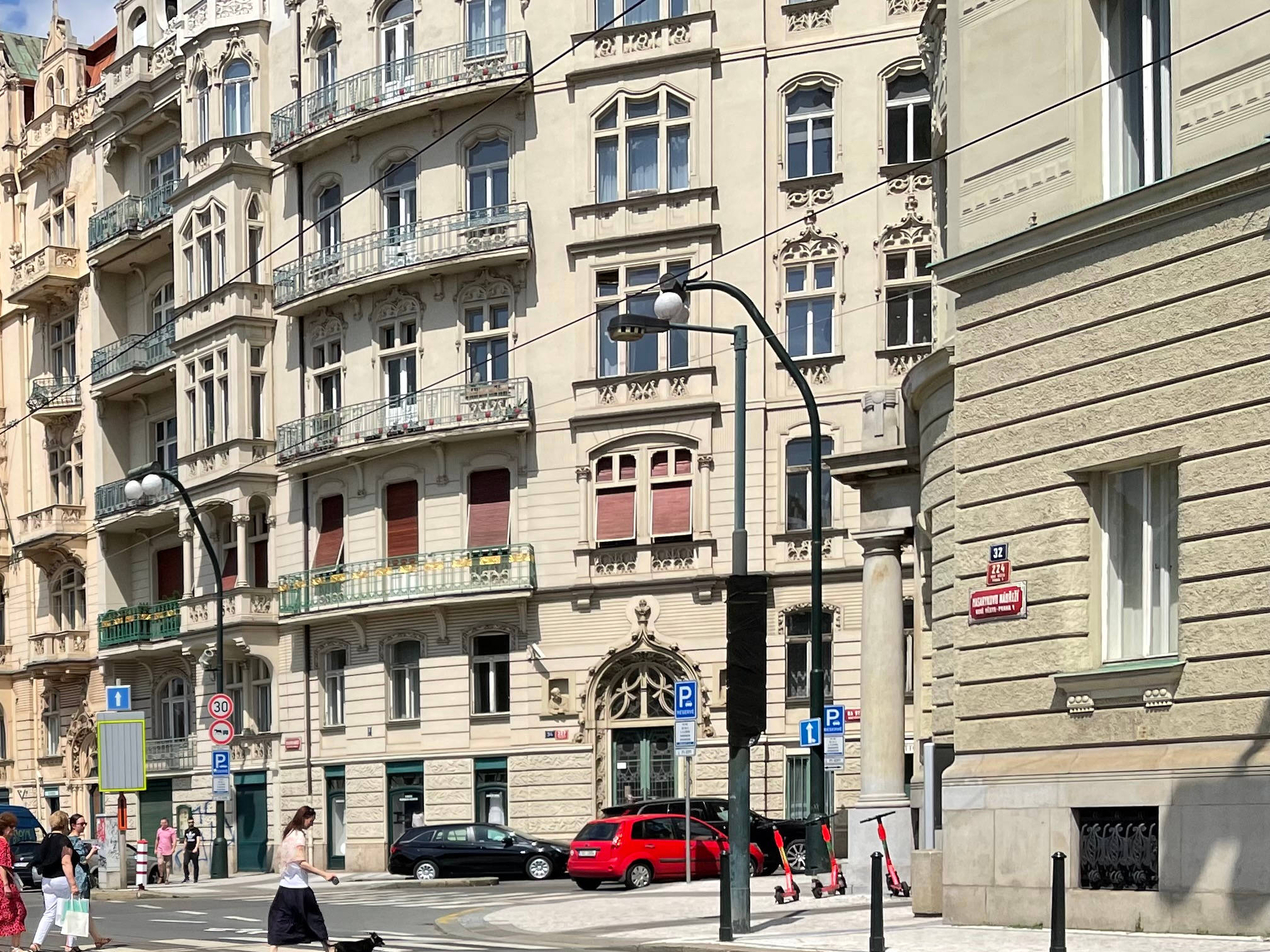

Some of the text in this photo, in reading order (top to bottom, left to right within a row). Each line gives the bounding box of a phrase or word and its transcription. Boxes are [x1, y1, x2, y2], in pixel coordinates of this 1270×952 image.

[993, 547, 1003, 559] 32
[992, 564, 1005, 574] 224
[679, 686, 692, 708] P
[213, 701, 228, 713] 30
[826, 708, 840, 727] P
[215, 753, 226, 768] P
